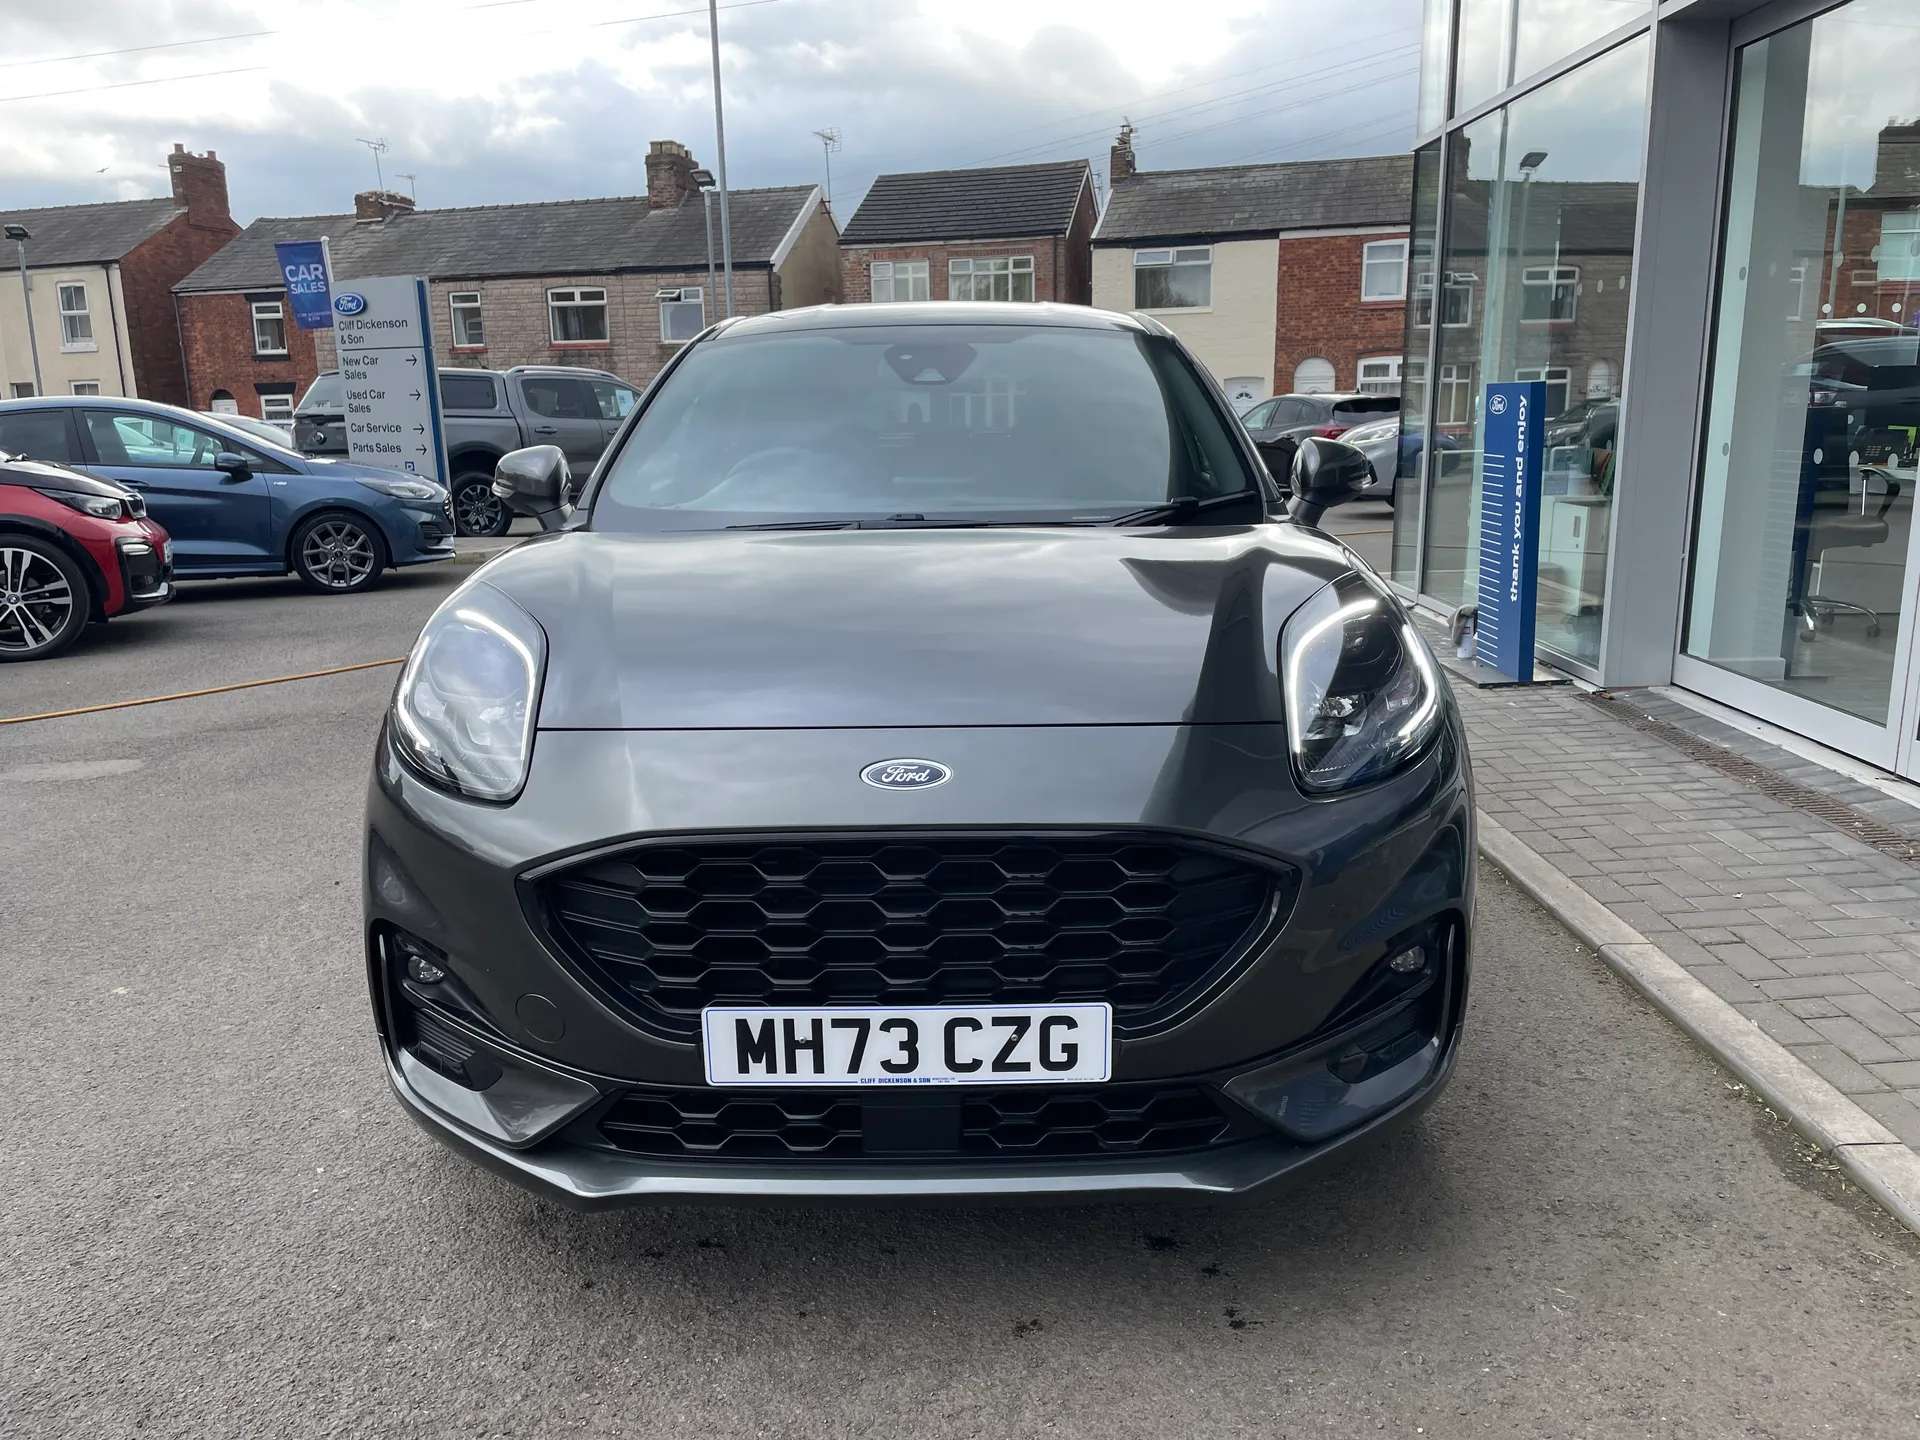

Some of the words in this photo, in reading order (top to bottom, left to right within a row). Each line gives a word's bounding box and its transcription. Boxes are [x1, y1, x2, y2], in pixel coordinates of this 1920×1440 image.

[285, 264, 323, 282] CAR
[291, 281, 326, 294] SALES
[338, 320, 354, 331] Cliff
[356, 319, 408, 330] Dickenson
[340, 335, 346, 344] &
[347, 334, 365, 344] Son
[342, 357, 361, 367] New
[362, 355, 379, 366] Car
[344, 369, 368, 380] Sales
[346, 389, 368, 400] Used
[369, 388, 386, 399] Car
[348, 403, 372, 414] Sales
[350, 423, 365, 433] Car
[366, 423, 402, 433] Service
[1517, 394, 1527, 453] enjoy
[352, 443, 374, 453] Parts
[375, 443, 402, 453] Sales
[1515, 457, 1524, 498] and
[1514, 501, 1522, 540] you
[1510, 543, 1520, 602] thank
[881, 765, 930, 783] Ford
[734, 1017, 920, 1075] MH73
[942, 1014, 1079, 1073] CZG
